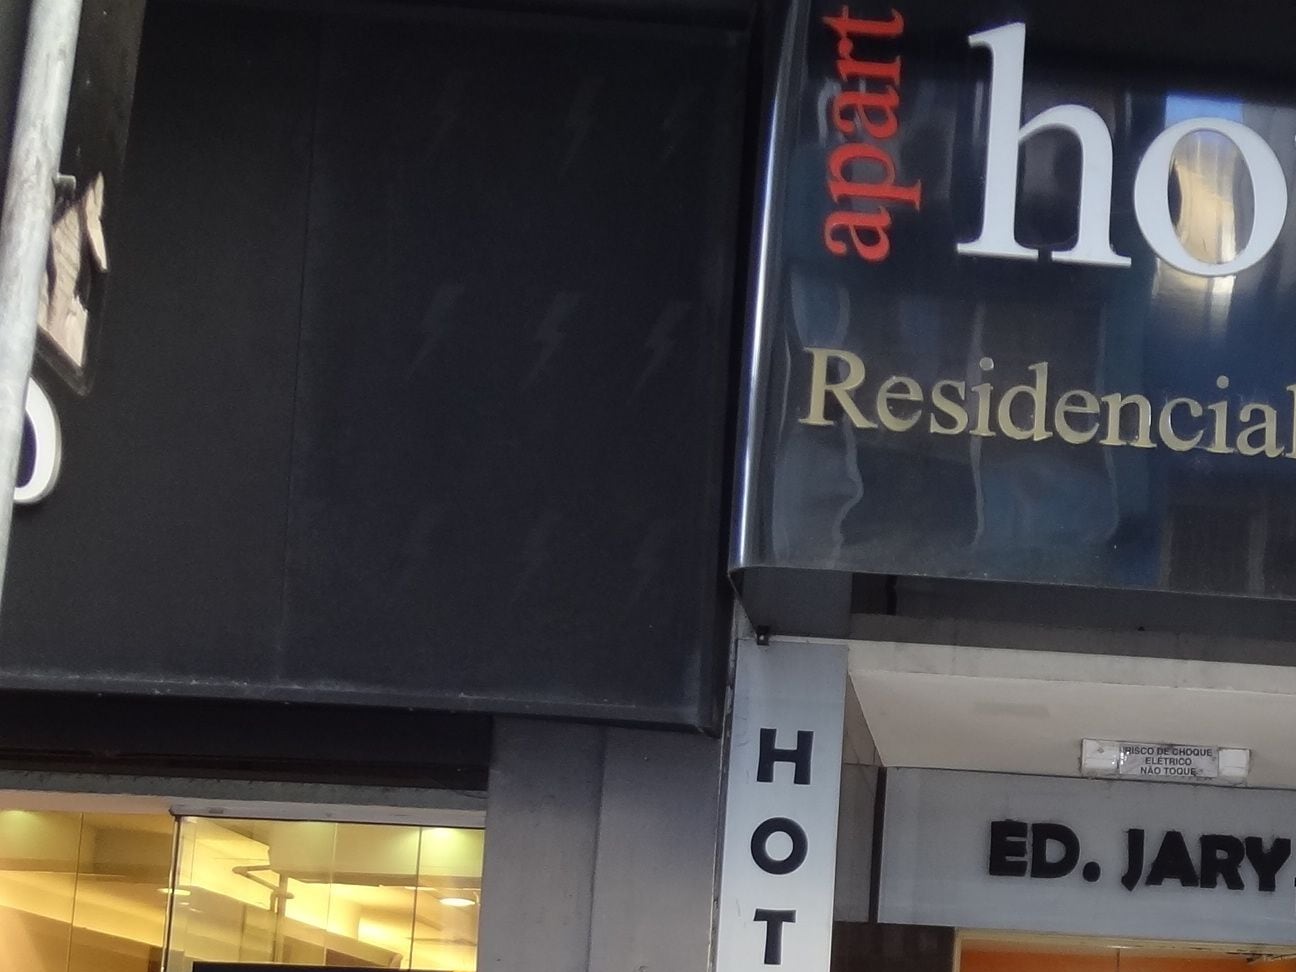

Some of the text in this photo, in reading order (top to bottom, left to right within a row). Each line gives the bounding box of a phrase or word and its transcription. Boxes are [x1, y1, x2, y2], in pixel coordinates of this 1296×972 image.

[823, 5, 921, 263] apart
[1123, 746, 1213, 757] RISCO DE CHOQUE
[1145, 756, 1192, 766] ELÉTRICO
[1140, 765, 1196, 776] NÃO TOQUE
[988, 818, 1292, 892] ED. JARY
